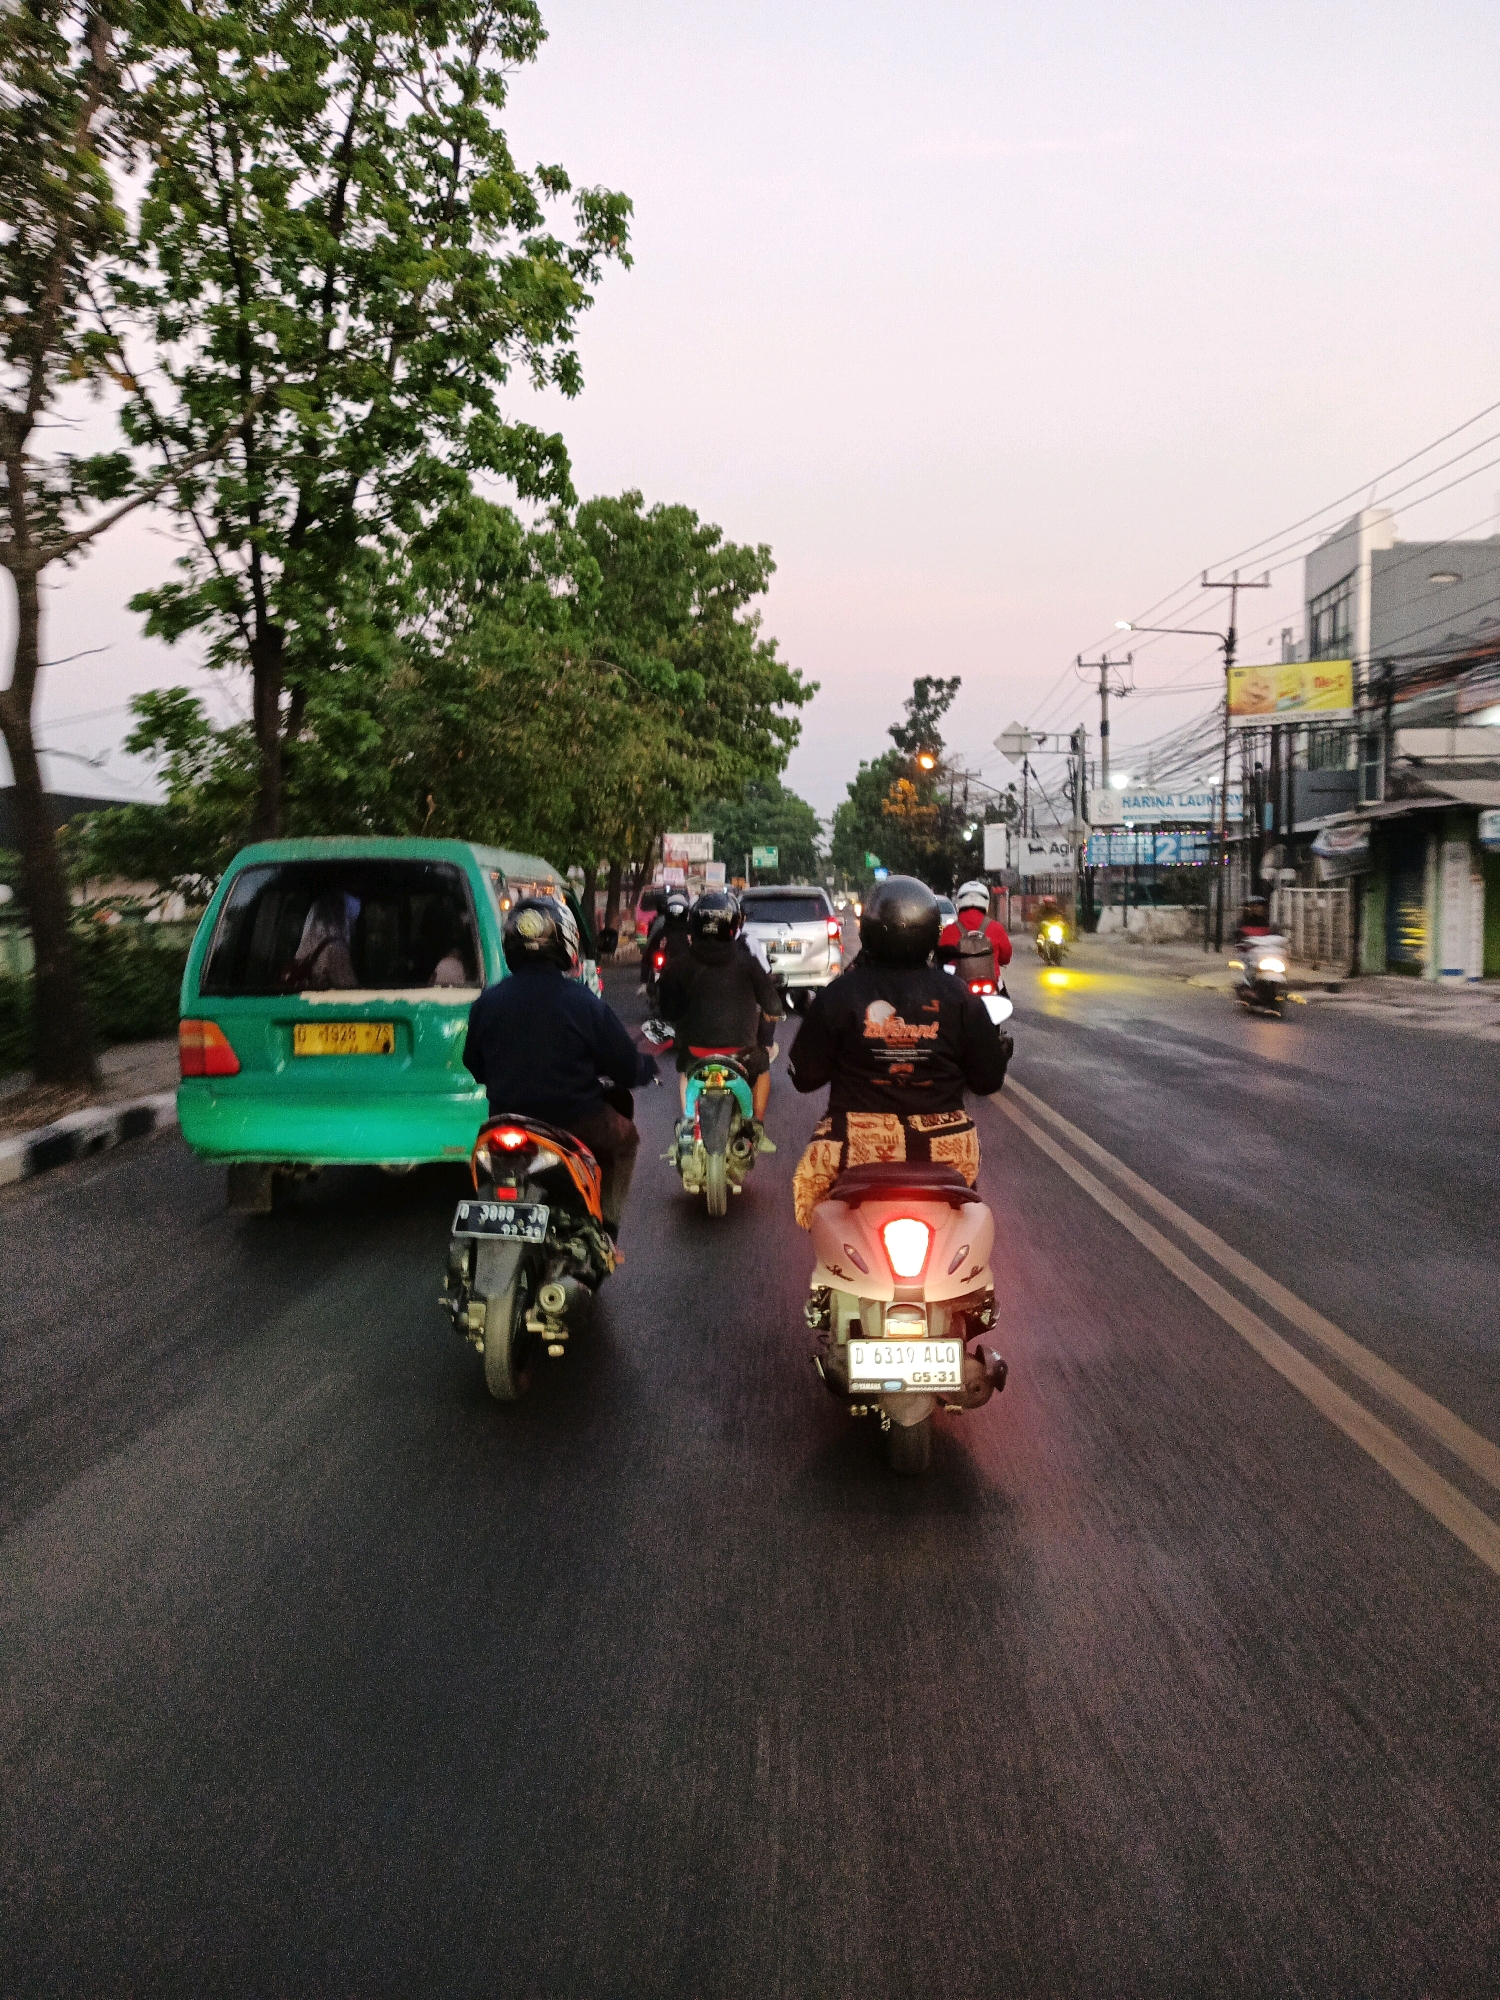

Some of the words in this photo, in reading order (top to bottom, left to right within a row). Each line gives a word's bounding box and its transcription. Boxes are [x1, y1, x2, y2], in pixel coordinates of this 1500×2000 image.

[1155, 837, 1177, 861] 2
[855, 1347, 865, 1365] D
[874, 1346, 915, 1364] 6319
